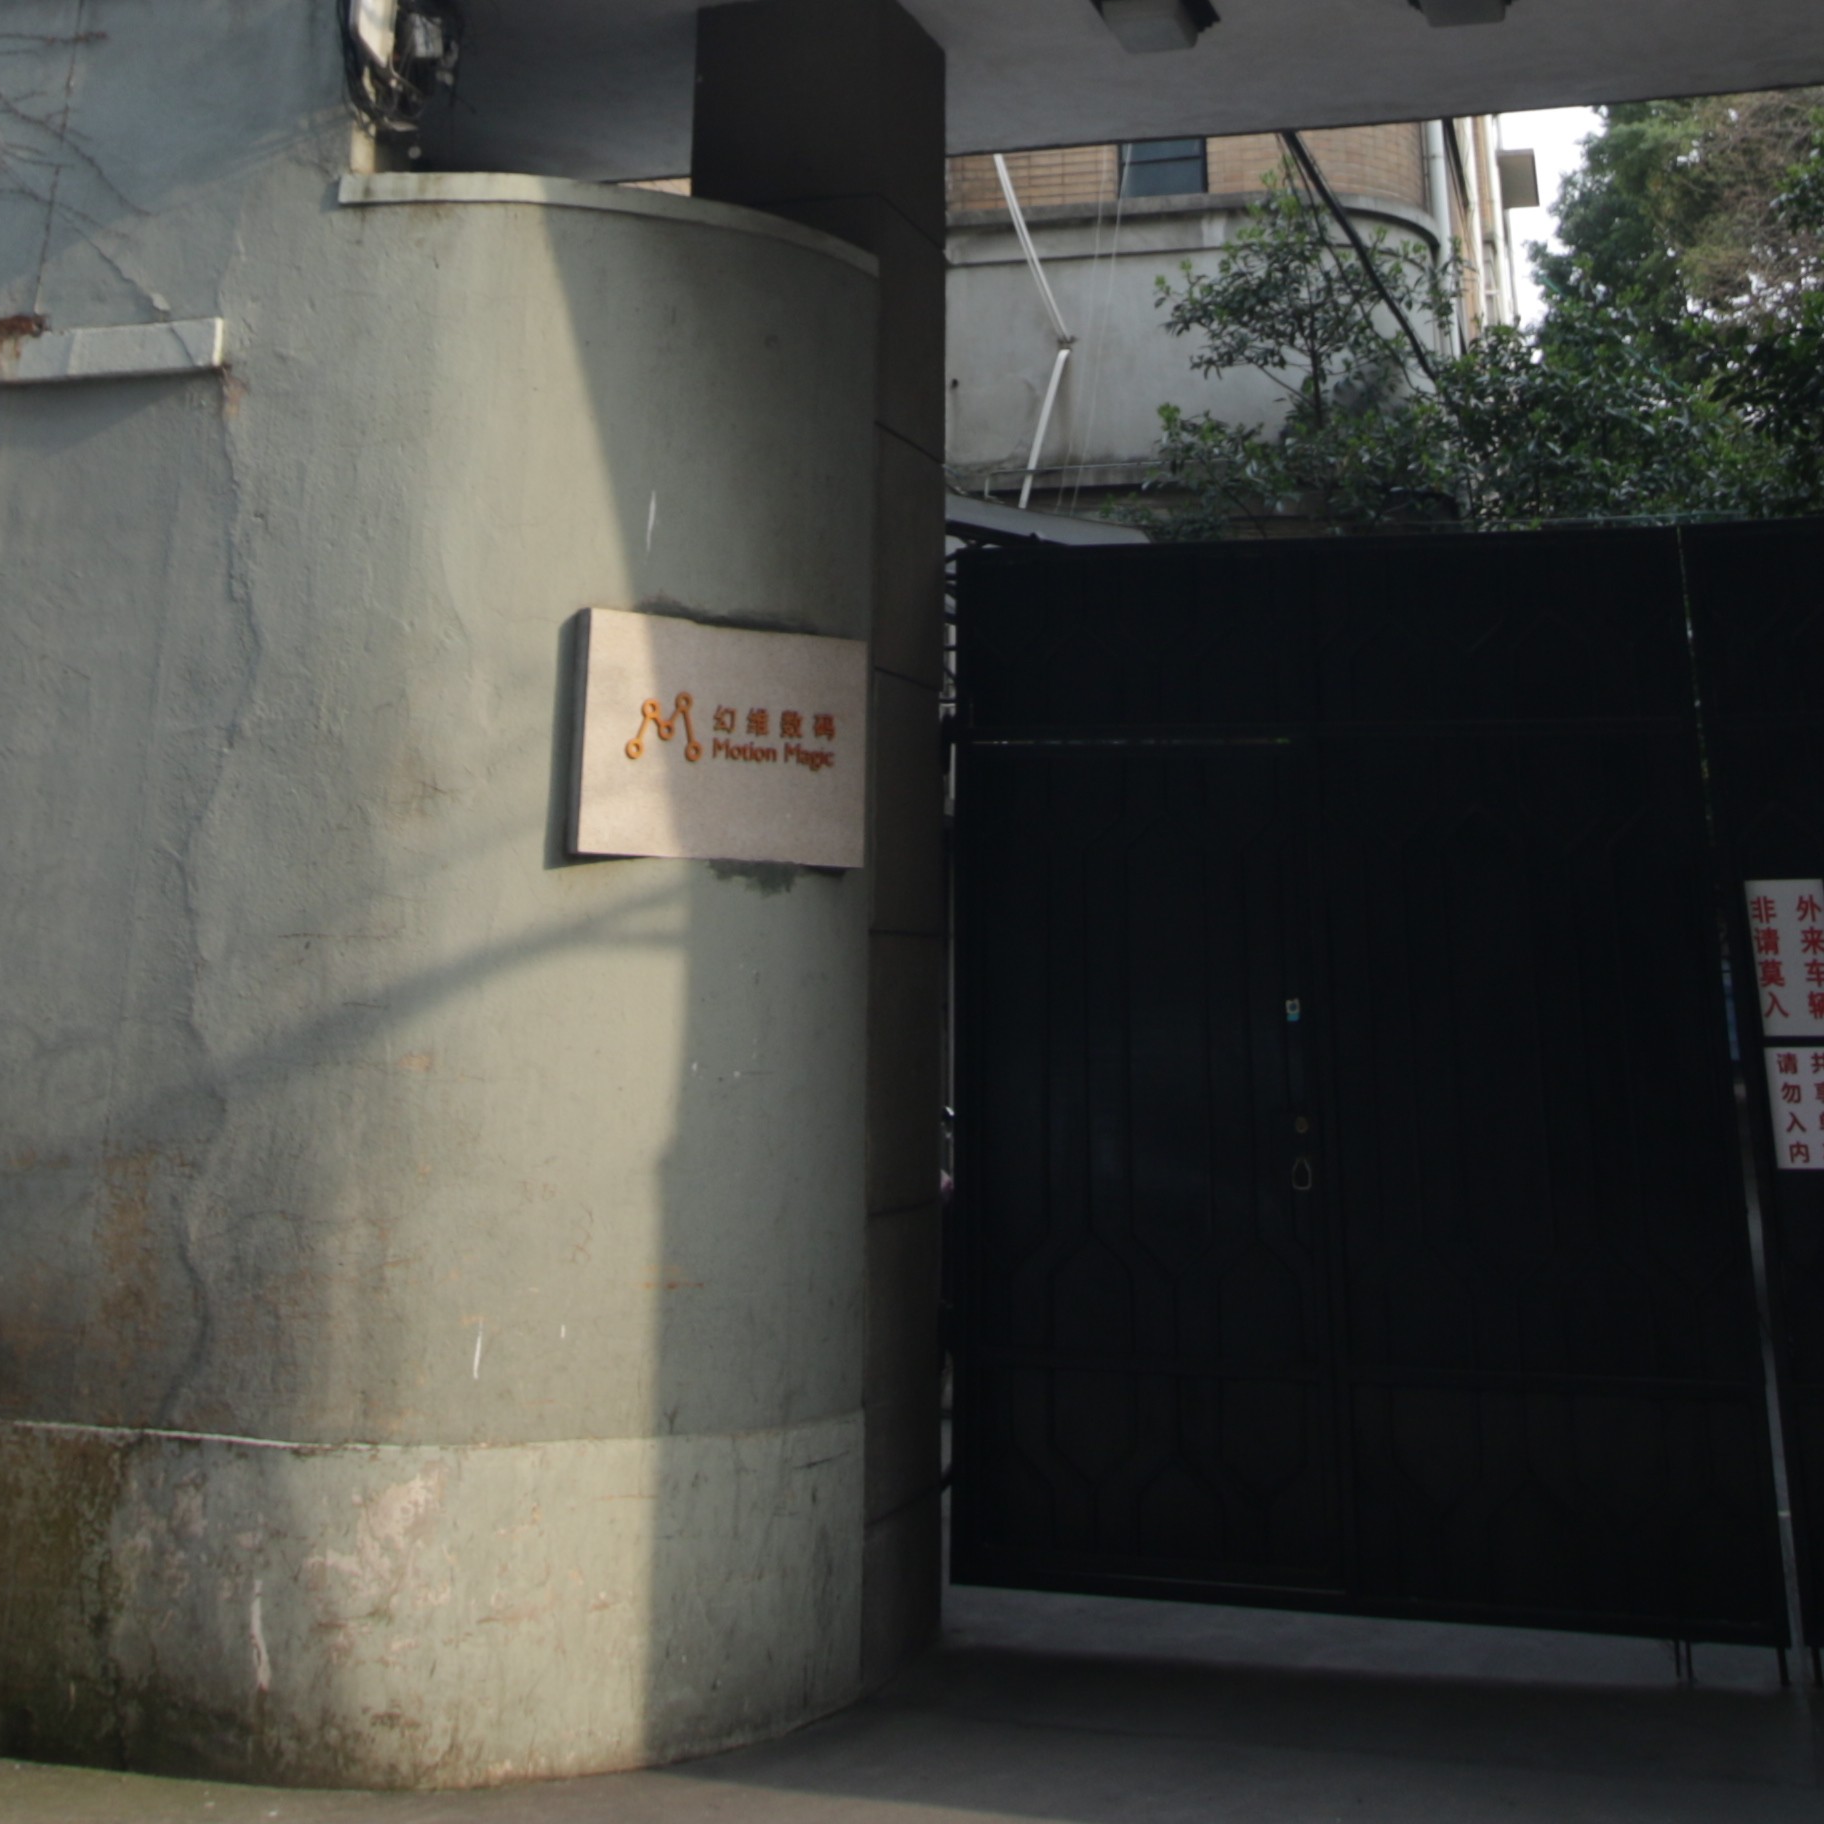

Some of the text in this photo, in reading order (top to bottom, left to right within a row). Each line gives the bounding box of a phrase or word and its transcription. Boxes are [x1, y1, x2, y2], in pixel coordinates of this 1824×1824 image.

[713, 706, 836, 740] 幻维数码
[713, 740, 835, 770] Motion Magic
[1750, 896, 1789, 1019] 非请莫入
[1776, 1052, 1810, 1164] 请勿入内
